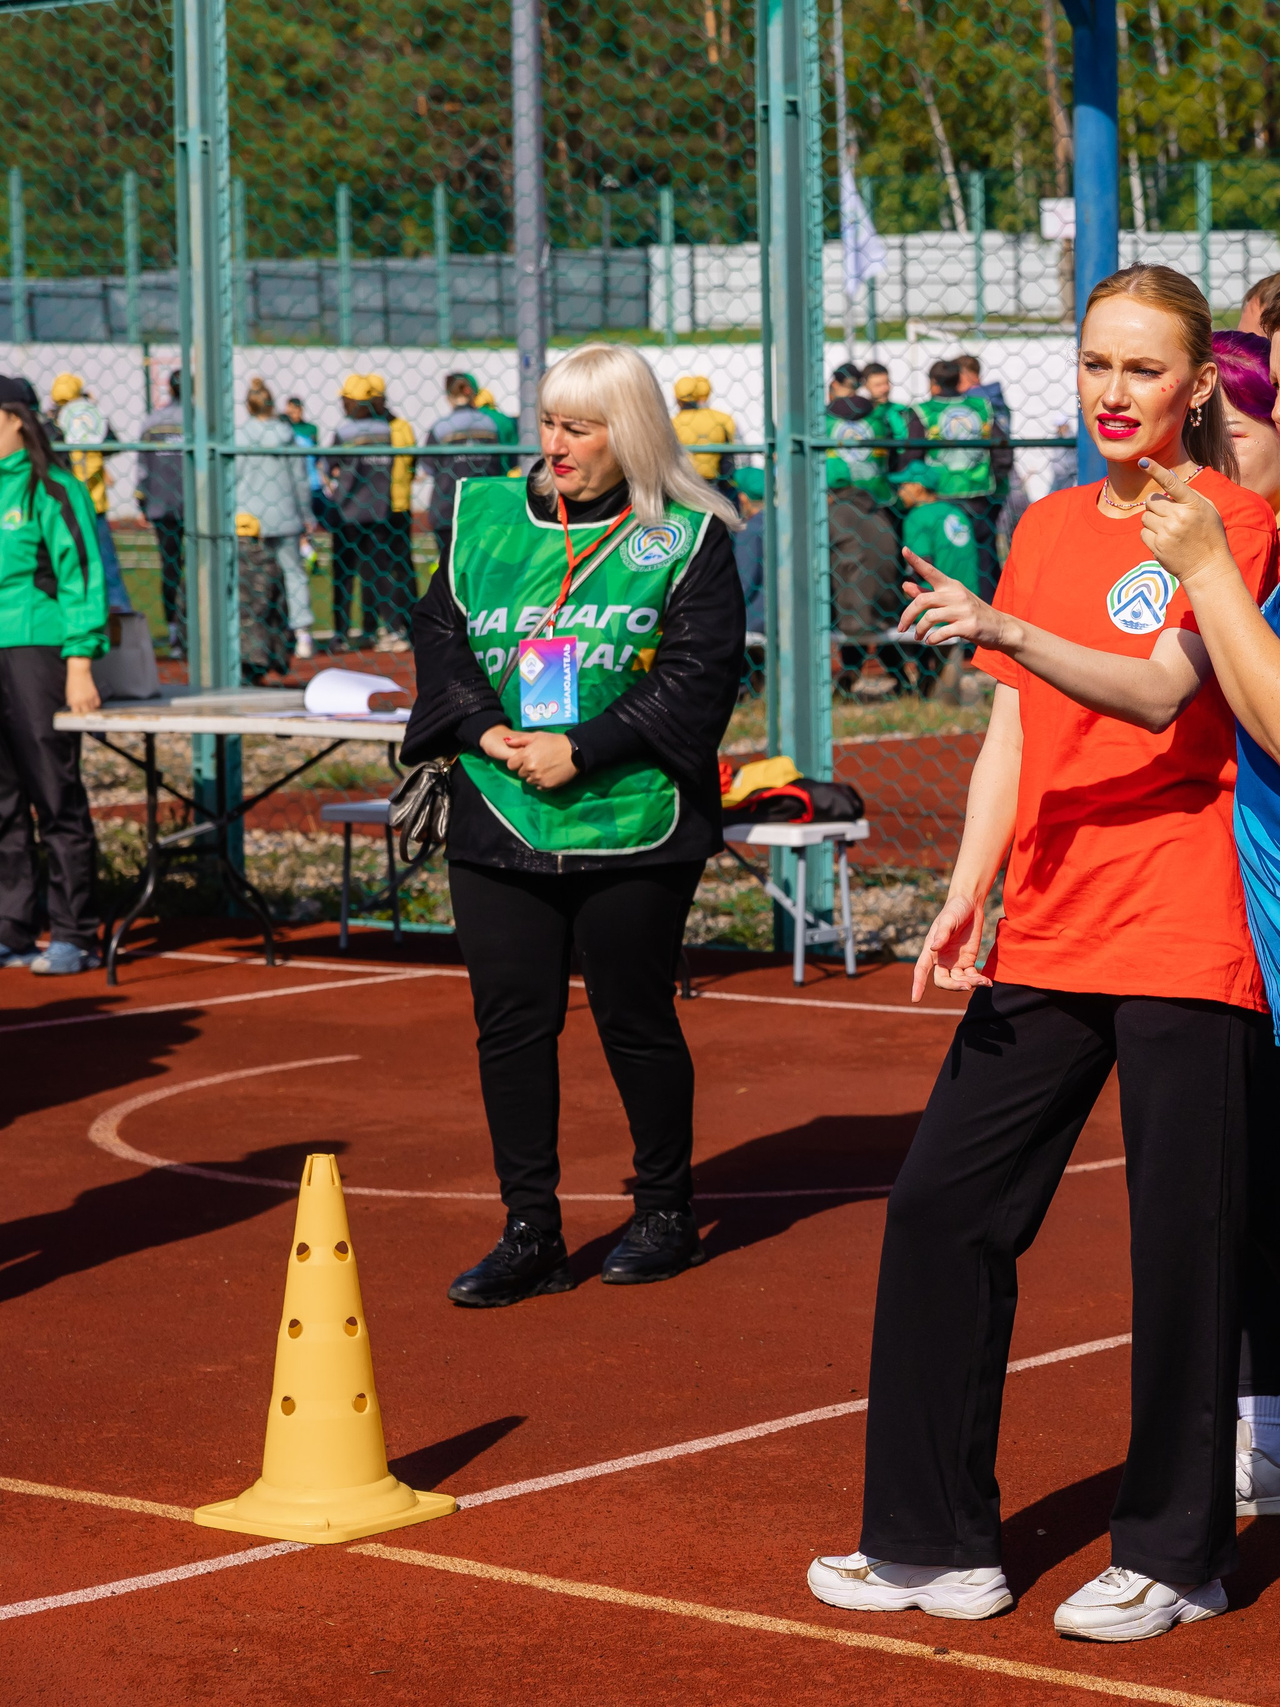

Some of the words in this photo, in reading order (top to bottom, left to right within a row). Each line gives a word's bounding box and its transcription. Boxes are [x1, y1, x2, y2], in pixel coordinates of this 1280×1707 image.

[467, 606, 508, 637] НА
[514, 604, 658, 634] БЛАГО
[563, 643, 572, 718] НАБЛЮДАТЕЛЬ
